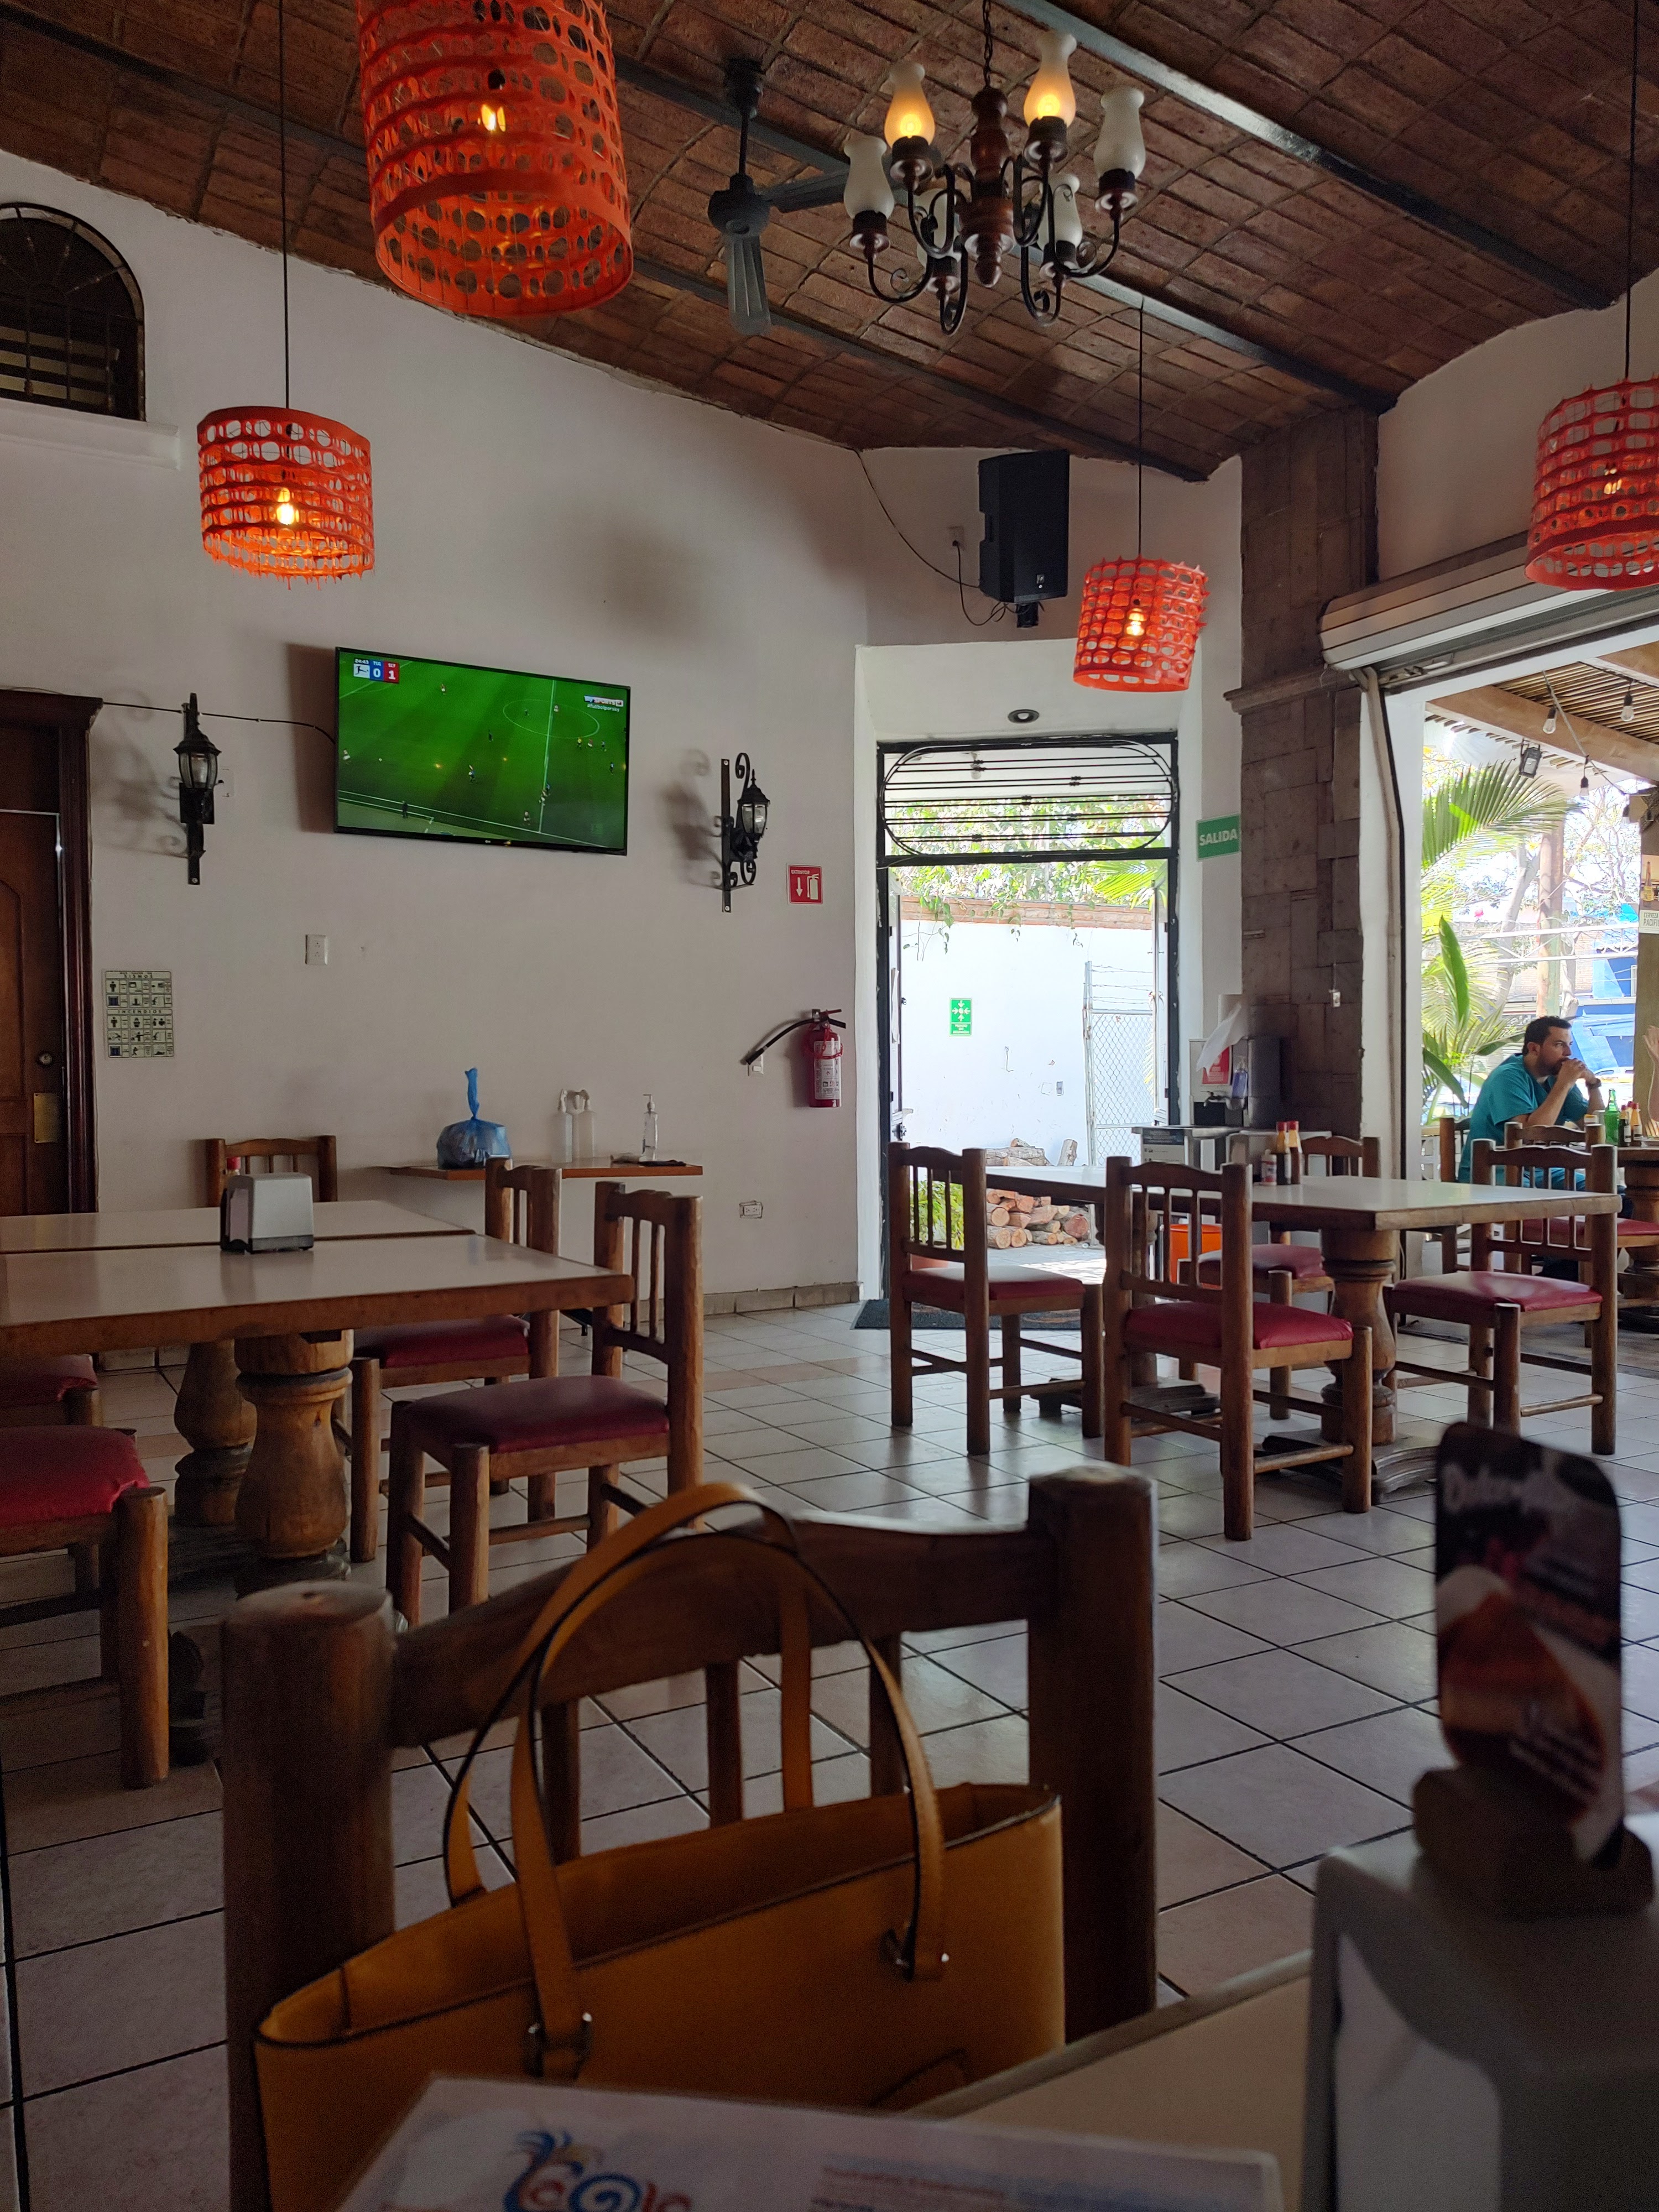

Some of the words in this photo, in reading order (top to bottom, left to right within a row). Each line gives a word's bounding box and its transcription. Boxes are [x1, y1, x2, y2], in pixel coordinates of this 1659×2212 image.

[373, 668, 381, 677] 0
[388, 670, 396, 680] 1
[1199, 828, 1238, 846] SALIDA
